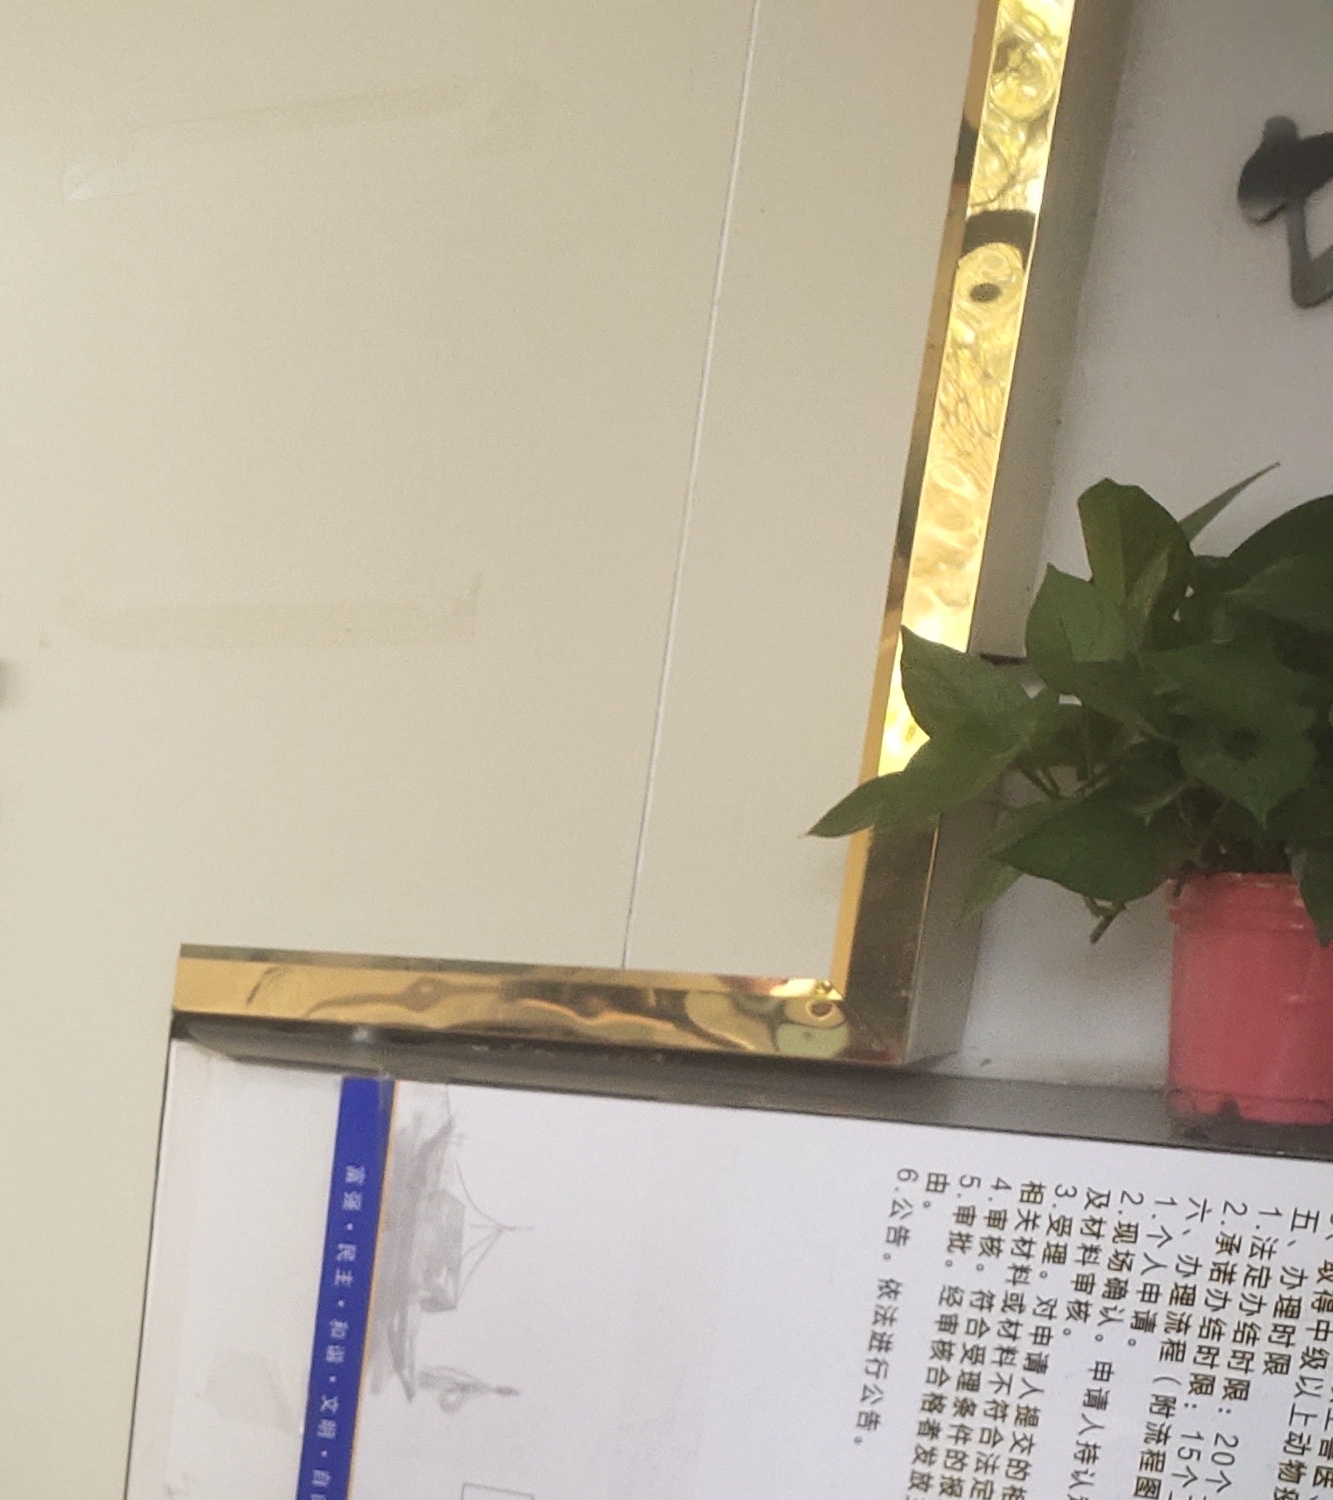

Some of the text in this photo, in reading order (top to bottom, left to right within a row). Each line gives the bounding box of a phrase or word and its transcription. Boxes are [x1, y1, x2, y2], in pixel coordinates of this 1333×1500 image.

[923, 1171, 949, 1209] 由。
[1062, 1186, 1112, 1338] 及材料审核。
[854, 1168, 919, 1447] 6.公告。依法进行公告。
[1126, 1197, 1178, 1349] 1.个人申请。
[1262, 1207, 1321, 1376] 五、办理时限
